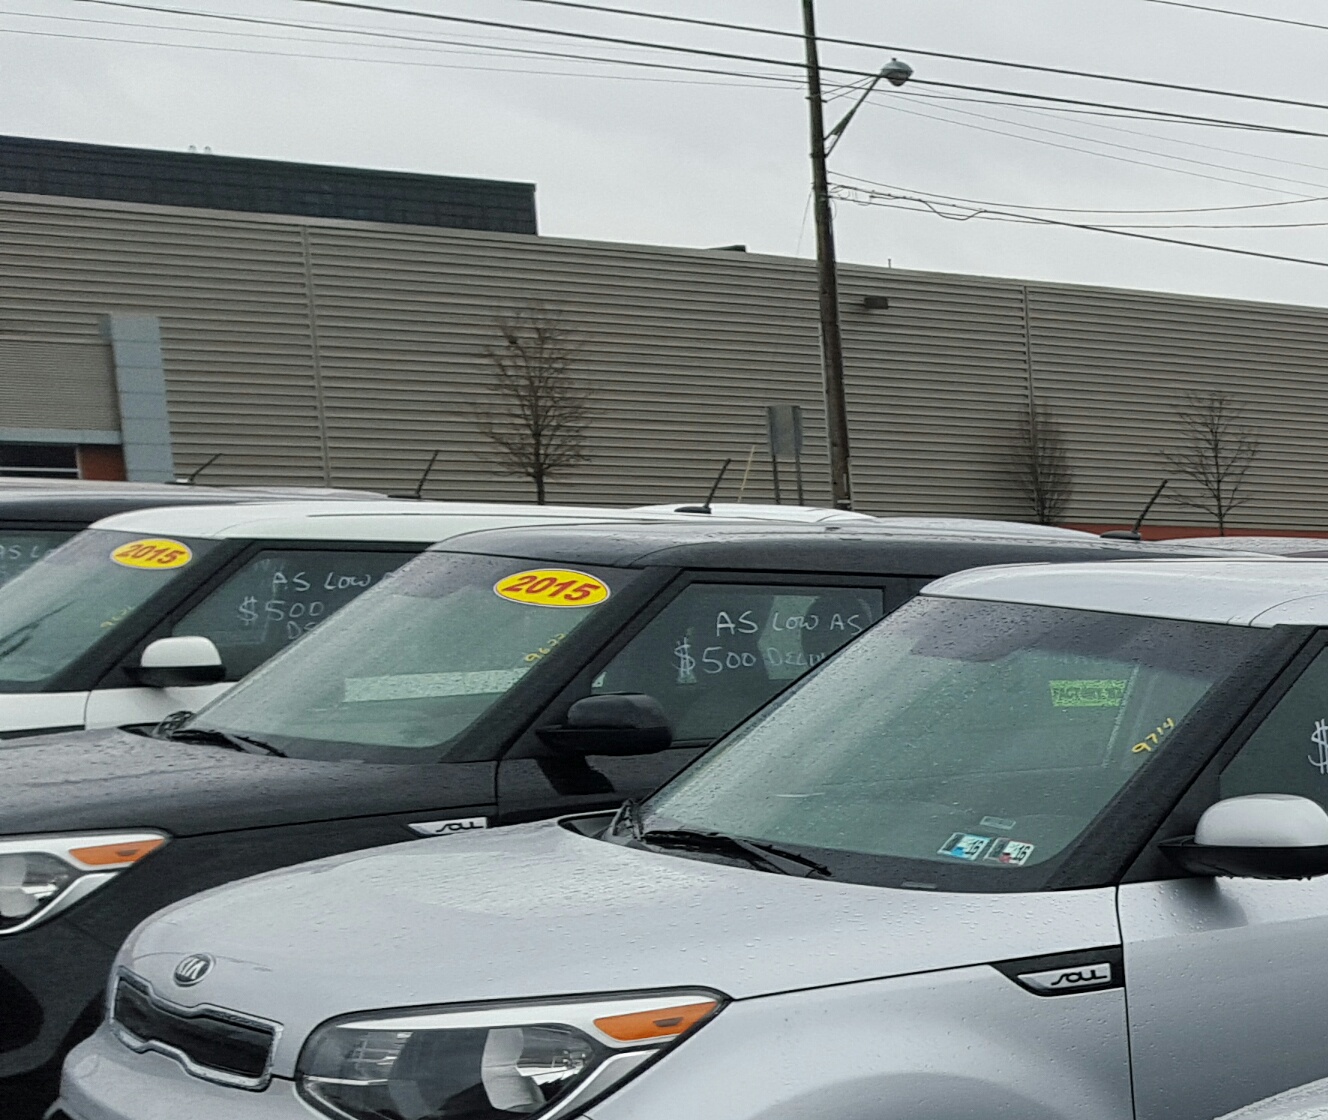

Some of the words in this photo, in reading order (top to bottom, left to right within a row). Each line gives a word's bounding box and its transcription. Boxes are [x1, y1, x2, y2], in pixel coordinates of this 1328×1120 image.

[115, 543, 187, 565] 2015
[272, 572, 311, 596] AS
[508, 574, 602, 602] 2015
[237, 596, 325, 625] $500
[716, 610, 759, 637] AS
[772, 613, 820, 632] LOW
[830, 613, 863, 636] AS
[671, 636, 757, 677] $500
